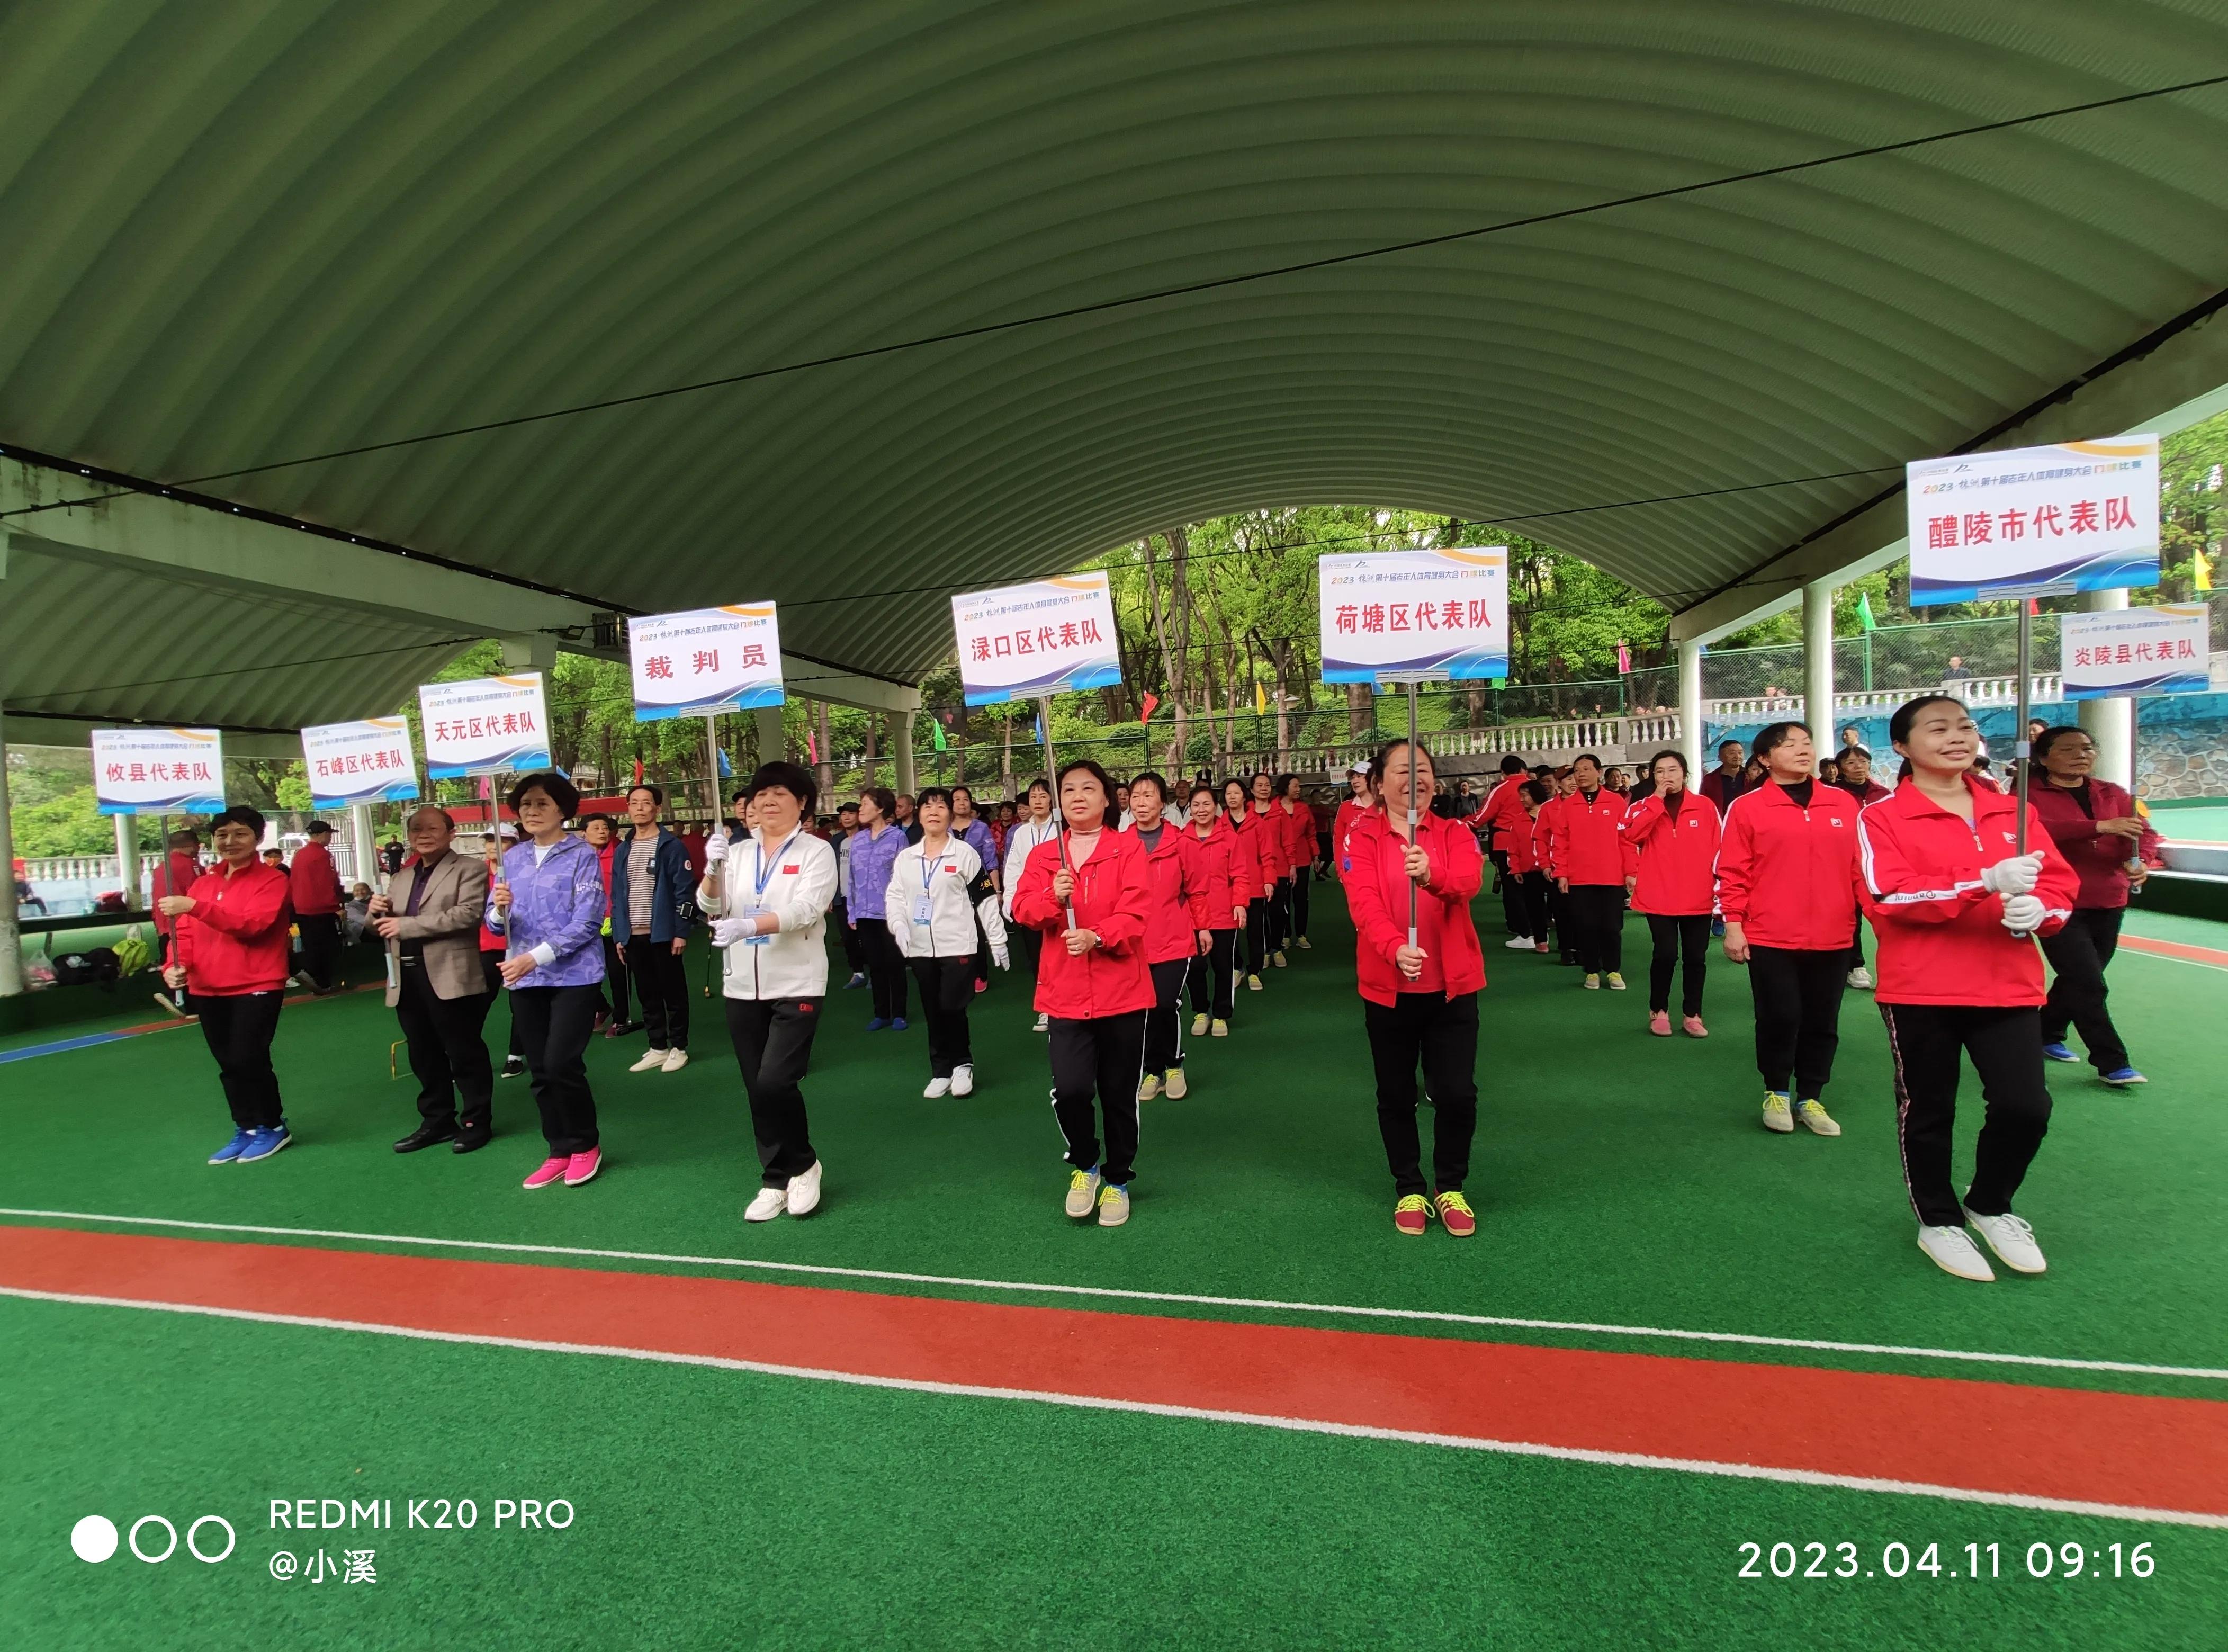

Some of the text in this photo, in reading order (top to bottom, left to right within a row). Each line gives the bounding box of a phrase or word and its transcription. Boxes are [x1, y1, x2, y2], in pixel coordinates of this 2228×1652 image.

[1928, 496, 2137, 549] 醴陵市代表队
[1335, 599, 1492, 634] 荷塘区代表队
[971, 618, 1103, 662] 渌口区代表队
[2075, 638, 2196, 667] 炎陵县代表队
[645, 644, 768, 680] 裁判员
[435, 711, 536, 742] 天元区代表队
[106, 762, 212, 782] 攸县代表队
[316, 749, 405, 777] 石峰区代表队
